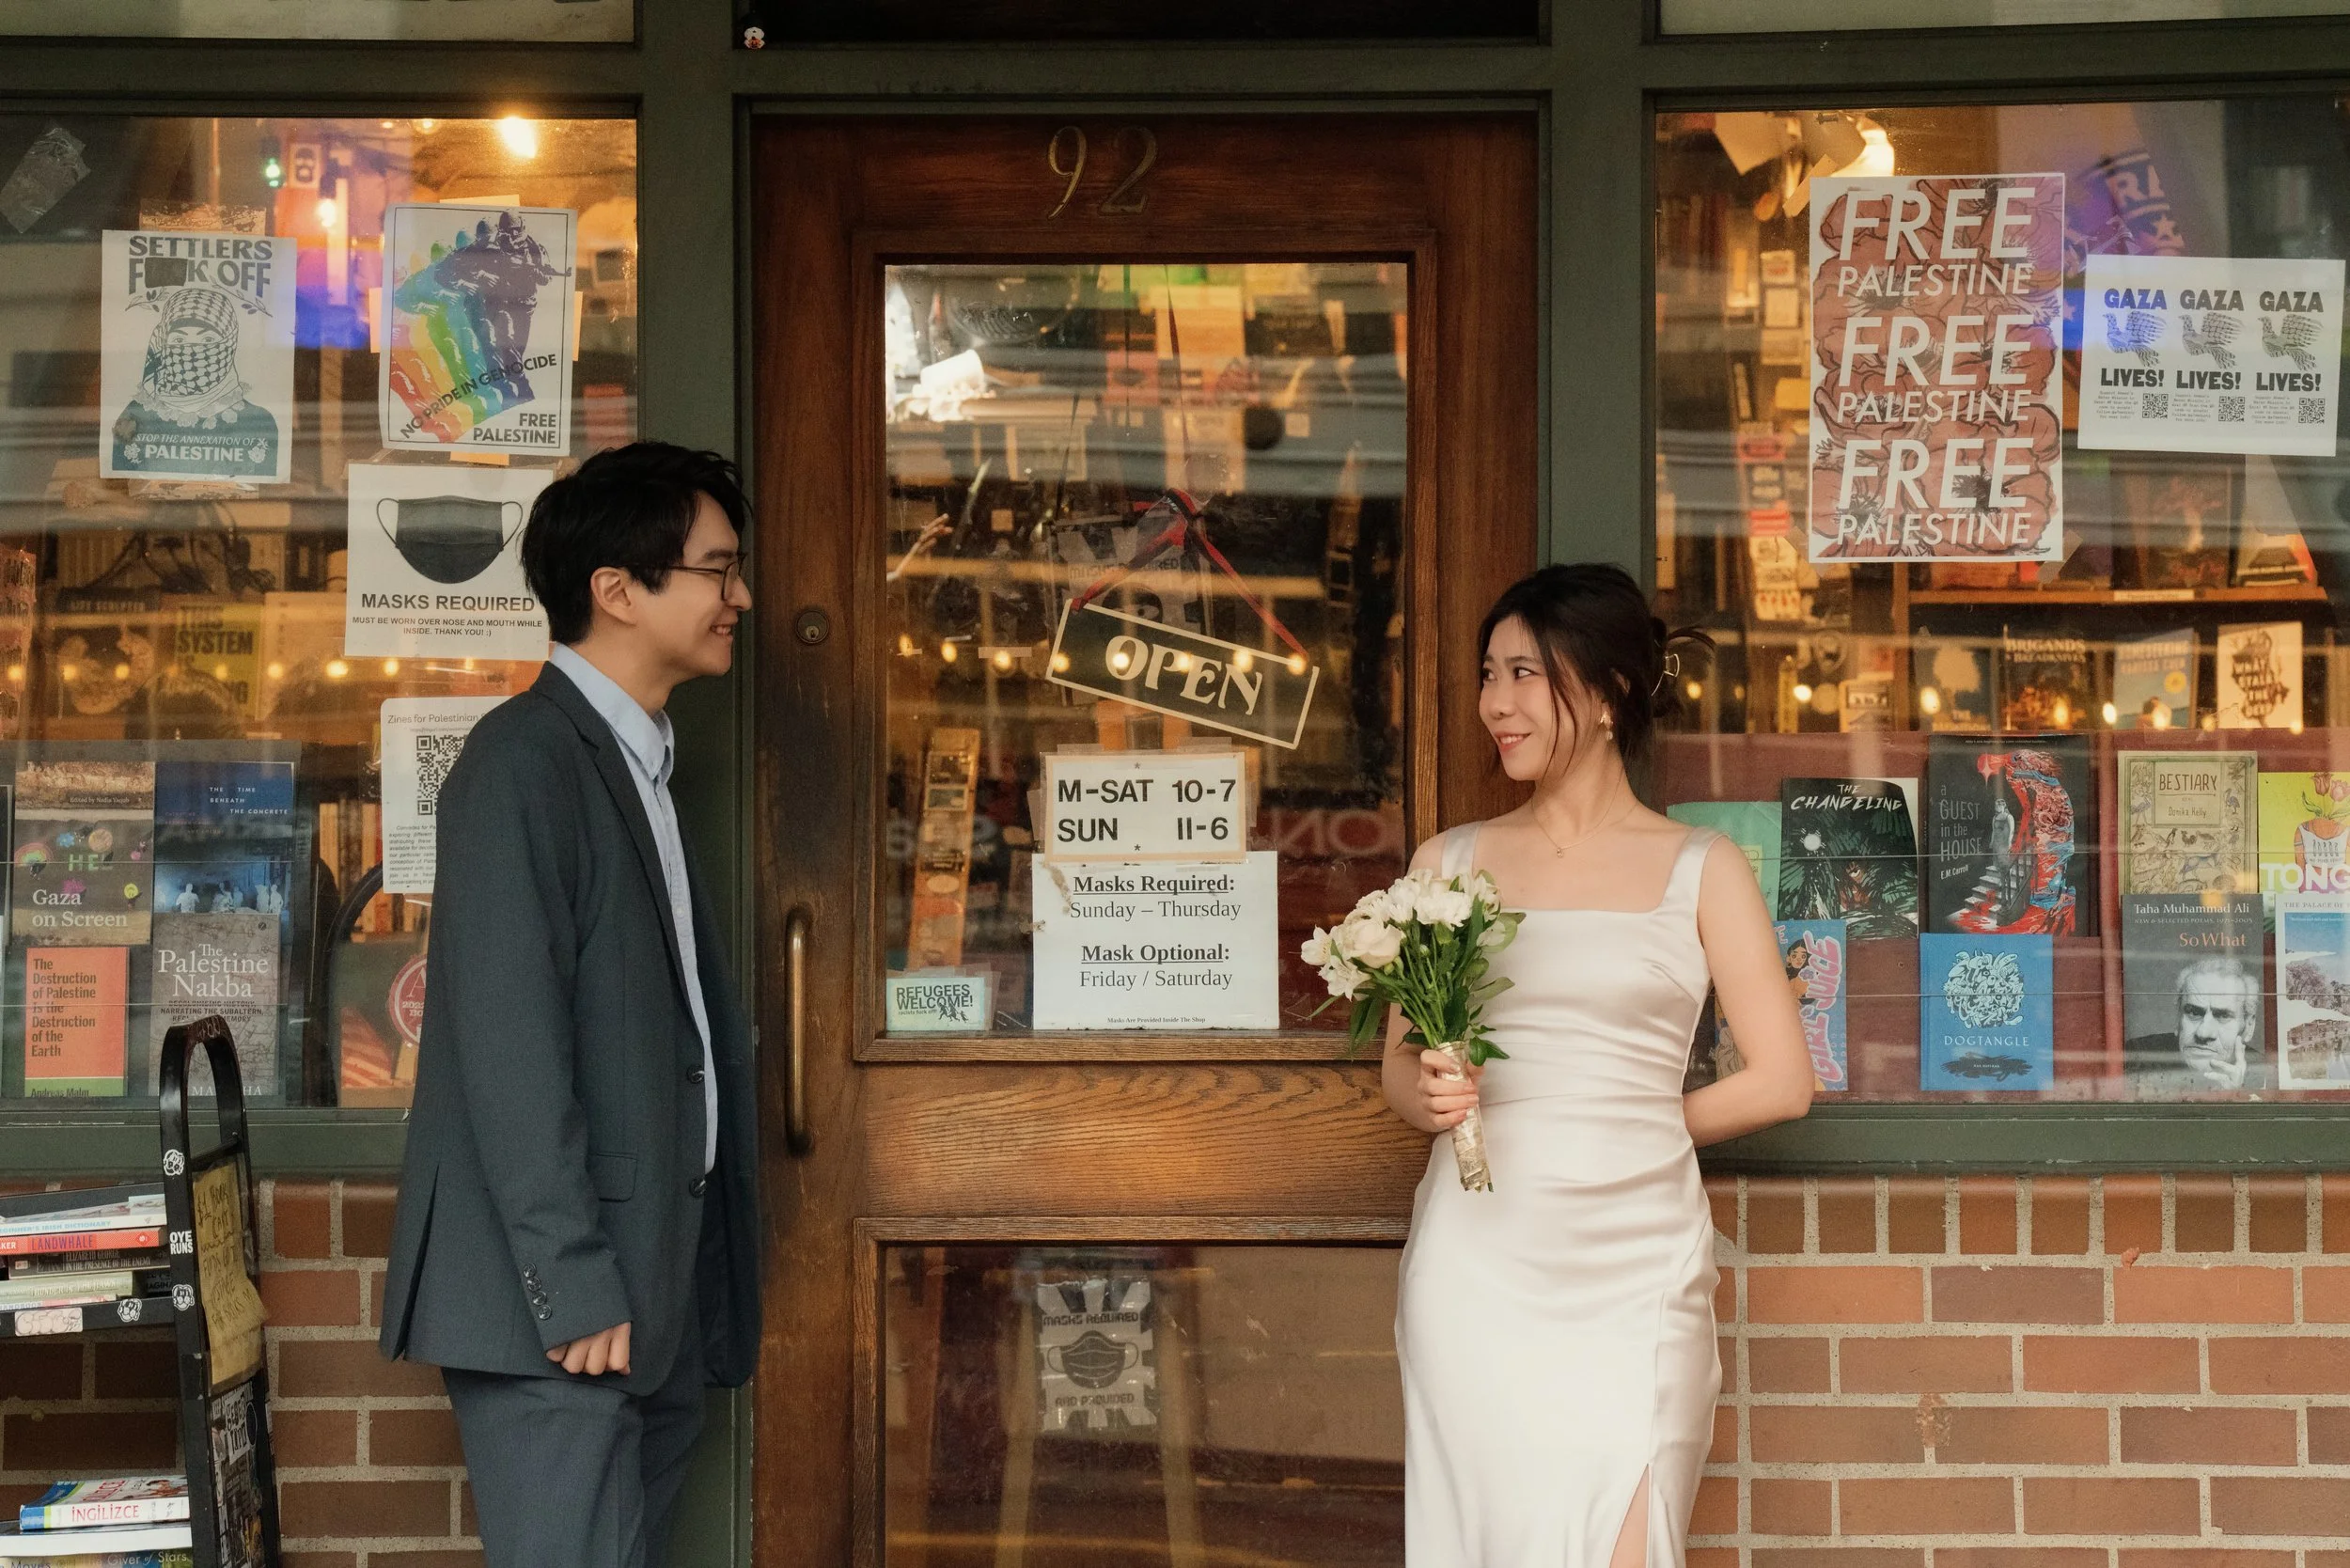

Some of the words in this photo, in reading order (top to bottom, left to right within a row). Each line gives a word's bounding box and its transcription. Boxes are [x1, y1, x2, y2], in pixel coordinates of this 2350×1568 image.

[1047, 125, 1159, 220] 92
[1840, 187, 2036, 261] FREE
[129, 235, 273, 260] SETTLERS
[129, 258, 209, 295] FK
[217, 260, 272, 298] OFF
[1838, 263, 2034, 297] PALESTINE
[2105, 289, 2167, 310] GAZA
[2180, 289, 2245, 311] GAZA
[2259, 290, 2324, 312] GAZA
[1838, 315, 2035, 387] FREE
[2101, 368, 2164, 387] LIVES!
[2176, 370, 2242, 389] LIVES!
[2256, 372, 2321, 391] LIVES!
[400, 416, 423, 439] NO
[423, 387, 462, 418] PRIDE
[462, 379, 478, 395] IN
[478, 353, 556, 385] GENOCIDE
[1837, 389, 2032, 422] PALESTINE
[519, 413, 556, 427] FREE
[135, 433, 160, 443] STOP
[180, 435, 240, 446] ANNEXATION
[242, 437, 255, 446] OF
[473, 428, 556, 444] PALESTINE
[145, 445, 244, 462] PALESTINE
[1839, 438, 2034, 509] FREE
[1837, 512, 2032, 545] PALESTINE
[361, 593, 430, 609] MASKS
[436, 595, 535, 611] REQUIRED
[177, 631, 254, 654] SYSTEM
[1104, 635, 1263, 715] OPEN
[387, 714, 412, 724] Zines
[414, 714, 426, 723] for
[429, 713, 478, 723] Palestinian
[1058, 779, 1154, 803] M-SAT
[1172, 779, 1236, 803] 10-7
[1837, 784, 1861, 794] THE
[1940, 785, 1947, 796] a
[2159, 774, 2217, 791] BESTIARY
[1791, 796, 1904, 811] CHANGELING
[1939, 799, 1980, 820] GUEST
[2168, 806, 2189, 817] Donika
[2191, 806, 2206, 818] Kelly
[1058, 817, 1119, 842] SUN
[1940, 823, 1950, 838] in
[1953, 823, 1968, 836] the
[1940, 837, 1982, 862] HOUSE
[1952, 864, 1968, 877] Carroll
[1073, 876, 1135, 892] Masks
[1140, 874, 1235, 896] Required:
[32, 889, 82, 905] Gaza
[1070, 901, 1136, 921] Sunday
[1157, 901, 1242, 920] Thursday
[2134, 903, 2159, 914] Taha
[2163, 903, 2231, 914] Muhammad
[2234, 903, 2249, 914] Ali
[32, 916, 56, 928] on
[61, 911, 128, 928] Screen
[2180, 933, 2199, 947] So
[2201, 933, 2246, 947] What
[198, 943, 223, 957] The
[1081, 945, 1134, 962] Mask
[1140, 944, 1230, 964] Optional:
[34, 959, 53, 970] The
[158, 949, 269, 974] Palestine
[33, 972, 96, 984] Destruction
[1803, 931, 1843, 1011] JUICE
[173, 974, 253, 997] Nakba
[1080, 971, 1136, 991] Friday
[1155, 969, 1233, 990] Saturday
[33, 986, 45, 998] of
[46, 986, 96, 999] Palestine
[896, 984, 971, 998] REFUGEES
[33, 1003, 43, 1013] Is
[46, 1001, 64, 1013] the
[896, 996, 973, 1011] WELCOME!
[32, 1015, 96, 1027] Destruction
[32, 1030, 45, 1043] of
[46, 1030, 64, 1043] the
[1944, 1035, 2029, 1046] DOGTANGLE
[31, 1045, 61, 1057] Earth
[30, 1088, 65, 1097] Andreas
[67, 1088, 89, 1097] Malm
[1, 1241, 16, 1249] KER
[31, 1234, 93, 1251] LANDWHALE
[169, 1231, 192, 1244] OYE
[170, 1242, 194, 1255] RUNS
[84, 1260, 112, 1269] PRESENCE
[112, 1260, 119, 1268] OF
[120, 1259, 131, 1267] THE
[1086, 1312, 1138, 1325] REQUIRED
[107, 1555, 140, 1566] Giver
[143, 1553, 153, 1566] of
[158, 1551, 187, 1563] Stars
